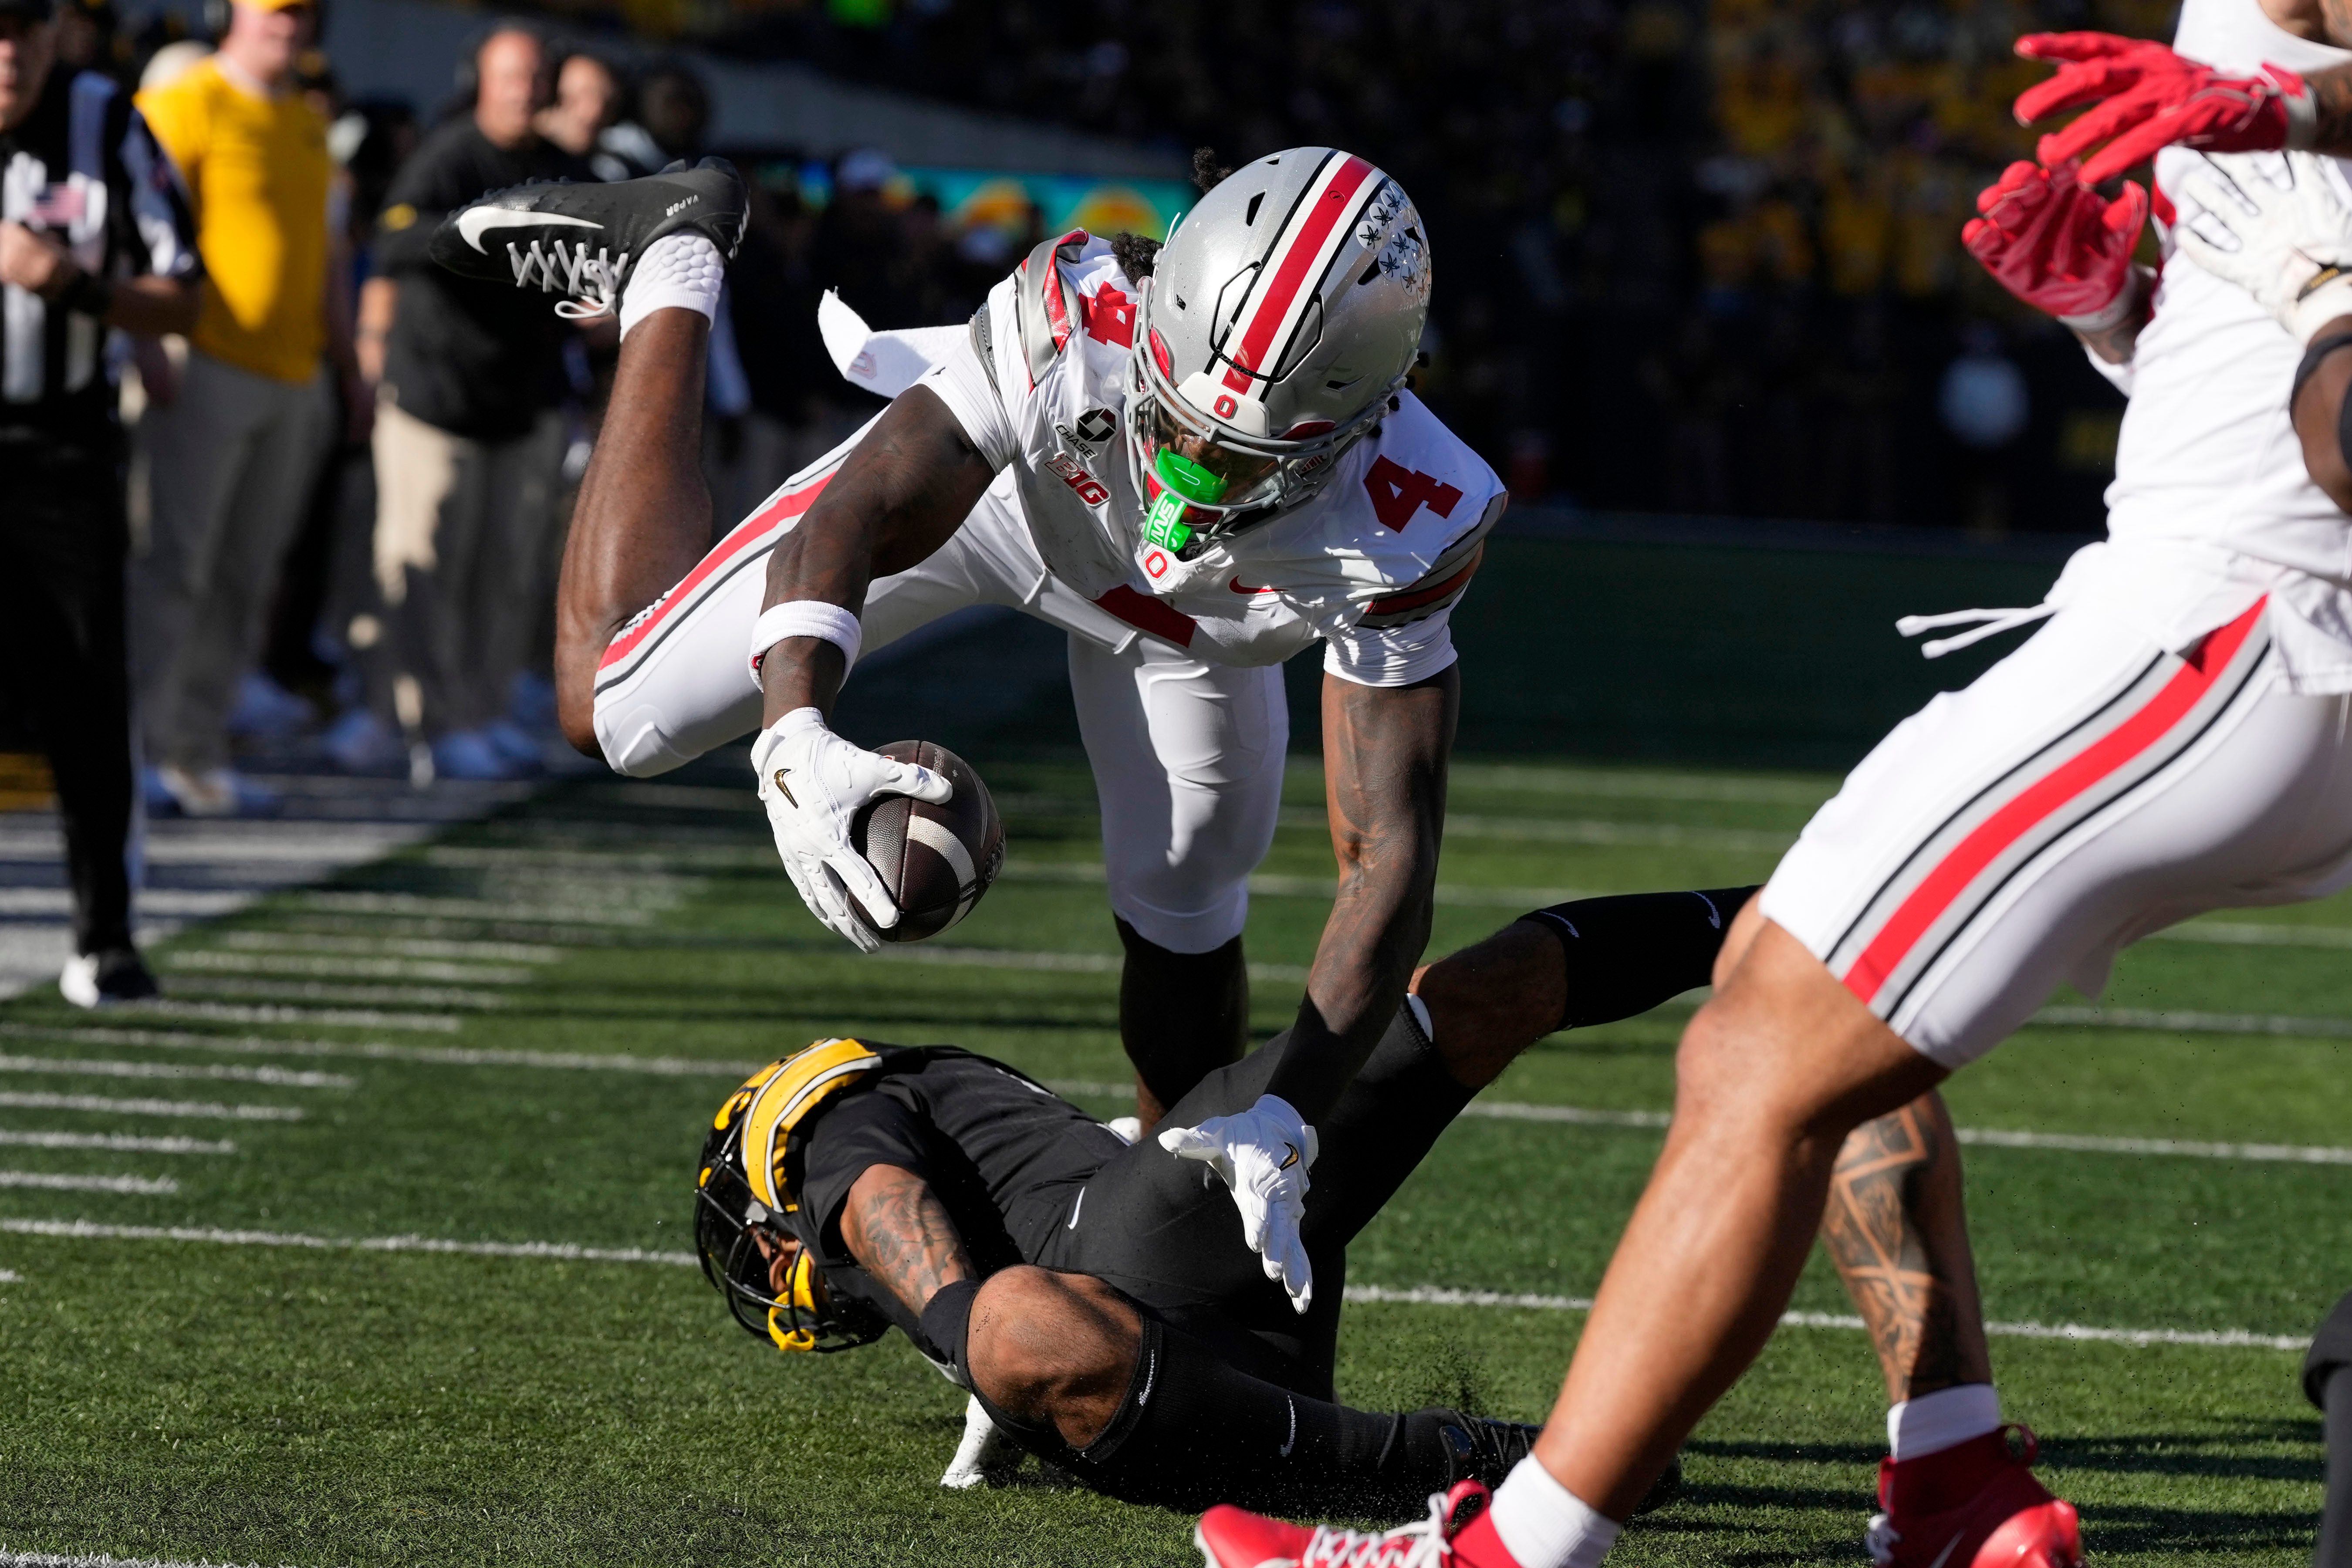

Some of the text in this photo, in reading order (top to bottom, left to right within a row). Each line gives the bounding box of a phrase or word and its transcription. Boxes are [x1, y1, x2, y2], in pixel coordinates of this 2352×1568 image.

[666, 195, 699, 217] VAPOR
[1213, 395, 1236, 418] O
[1056, 425, 1095, 458] CHASE
[1363, 454, 1464, 534] 4
[1146, 551, 1168, 578] O
